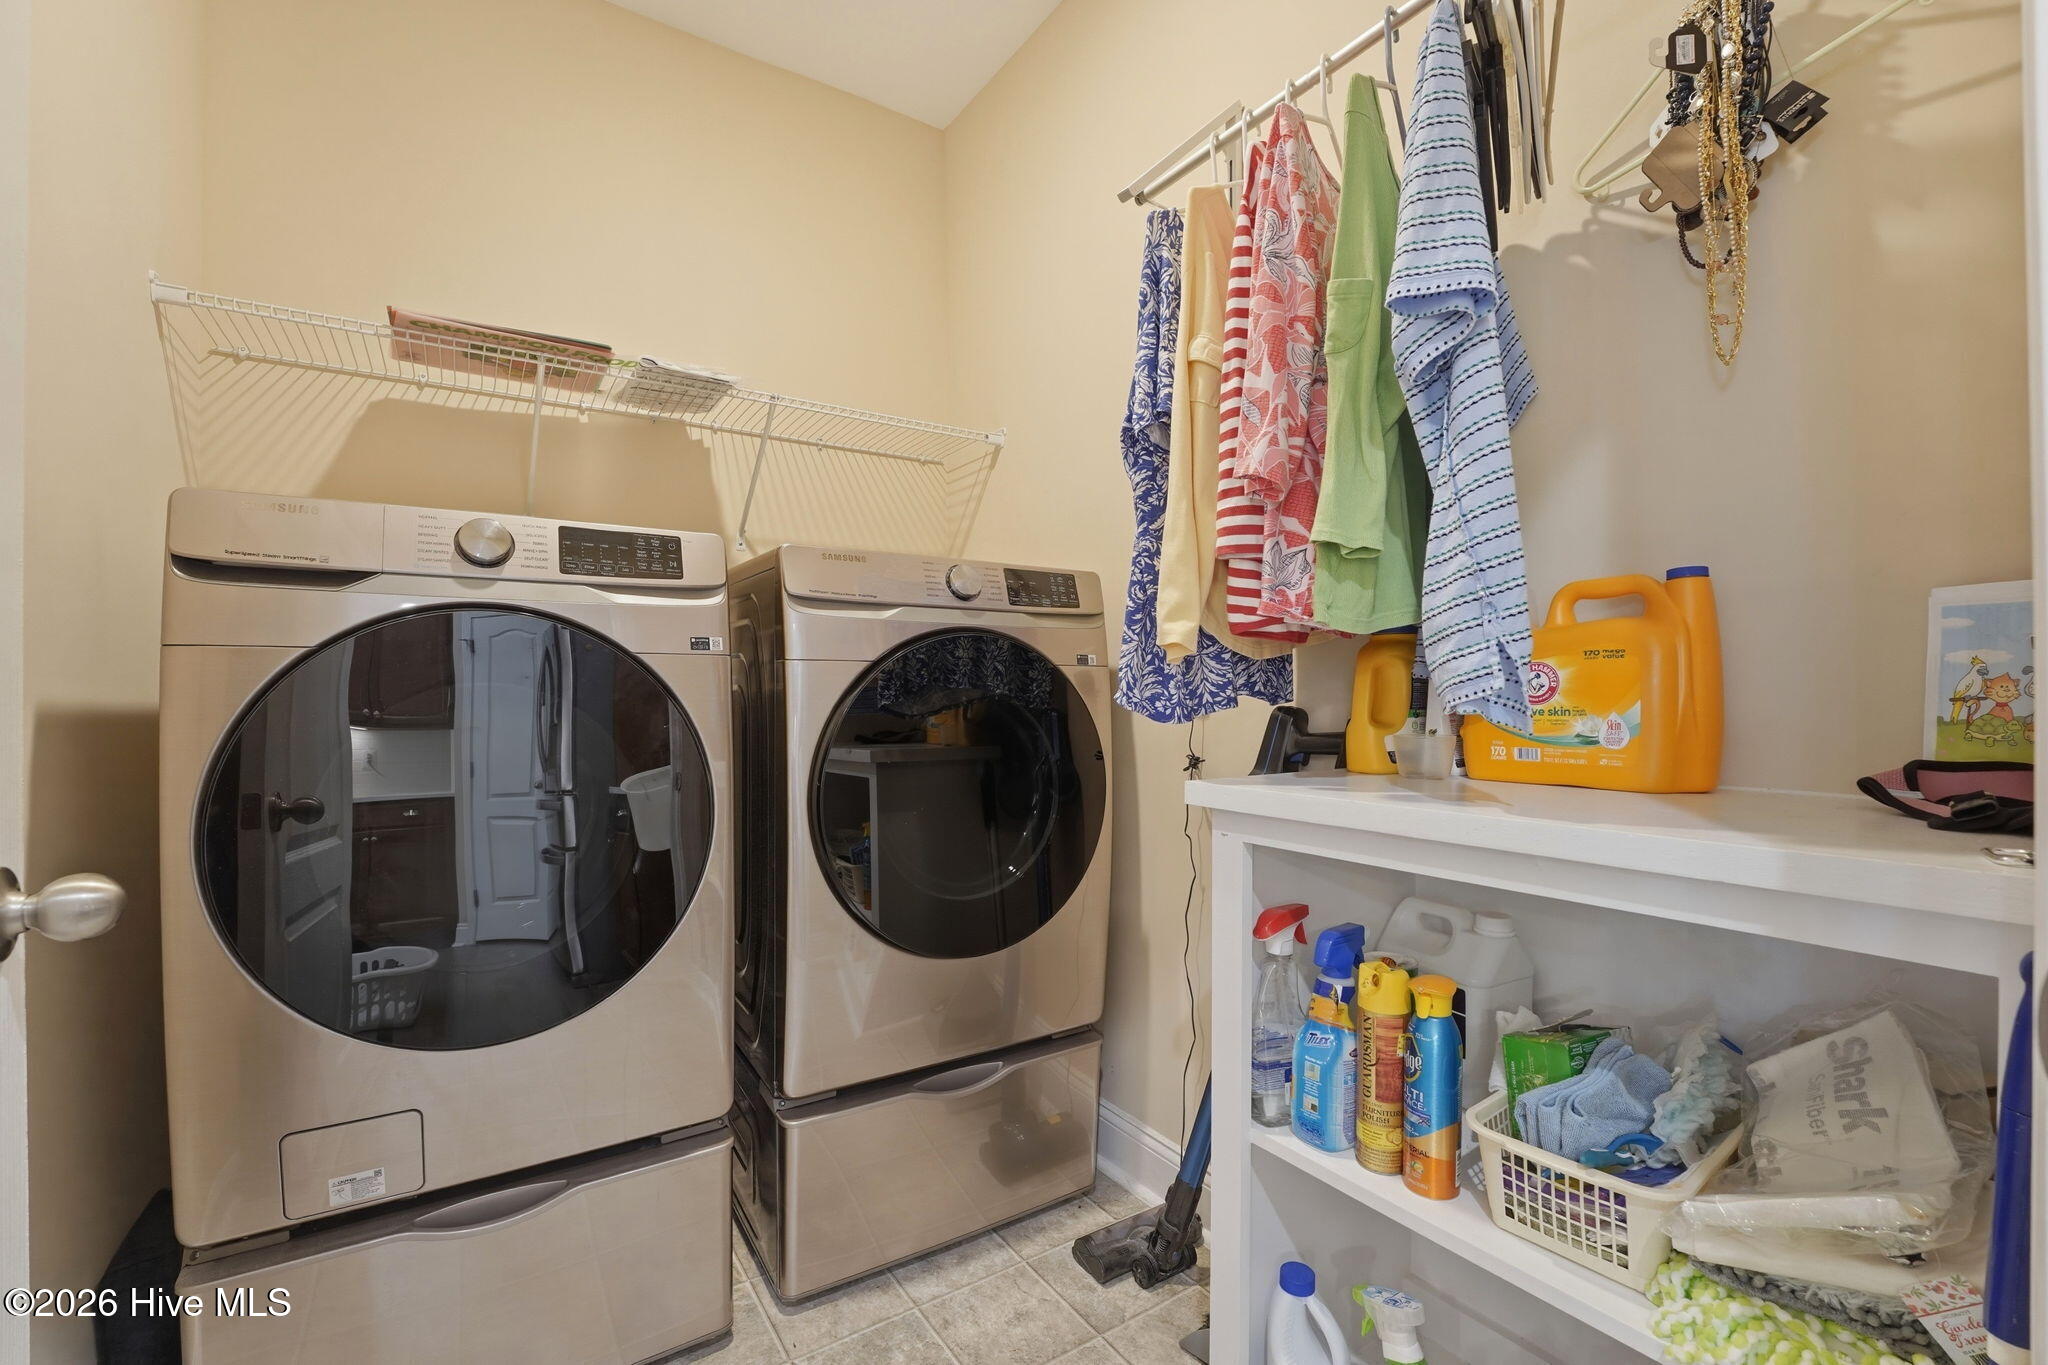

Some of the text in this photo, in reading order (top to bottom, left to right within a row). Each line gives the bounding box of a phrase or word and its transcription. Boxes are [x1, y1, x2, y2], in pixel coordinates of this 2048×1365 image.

[409, 319, 570, 354] CHAMPION
[822, 552, 867, 563] SAMSUNG
[1531, 664, 1558, 688] HAMMER
[1547, 706, 1571, 717] skin
[1606, 719, 1622, 731] Skin
[1490, 746, 1506, 756] 170
[1362, 1014, 1379, 1099] GUARDSMAN
[1826, 1036, 1889, 1135] Shark
[1362, 1111, 1390, 1125] POLISH
